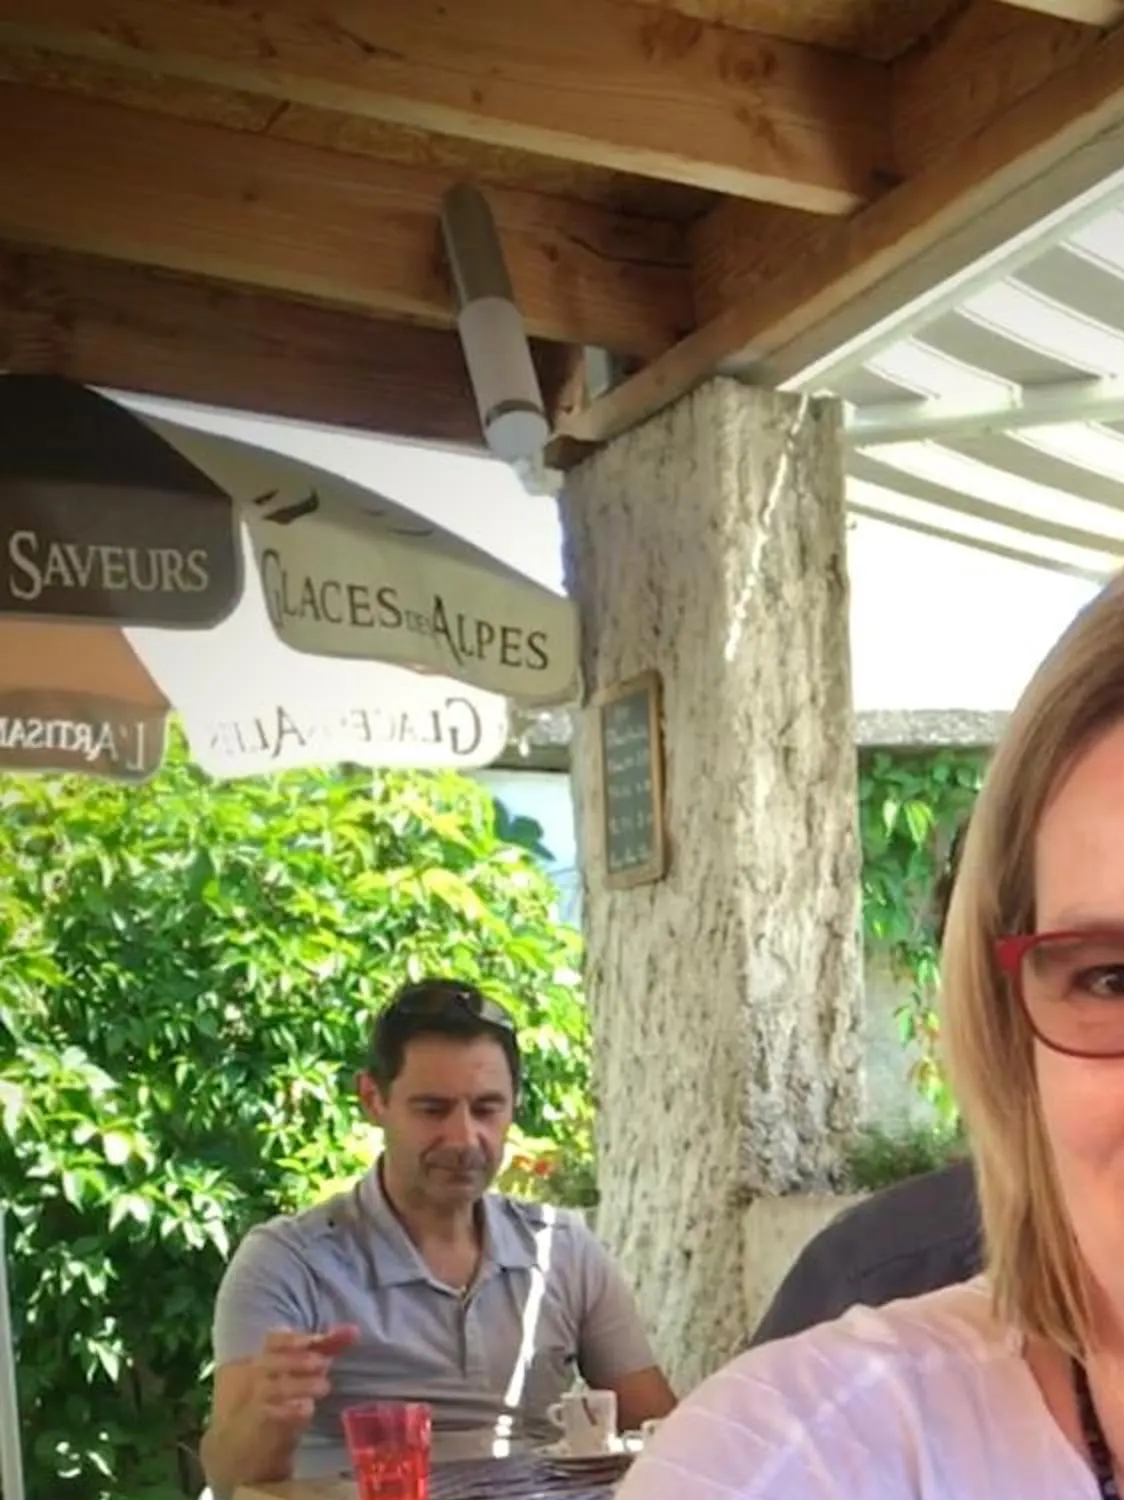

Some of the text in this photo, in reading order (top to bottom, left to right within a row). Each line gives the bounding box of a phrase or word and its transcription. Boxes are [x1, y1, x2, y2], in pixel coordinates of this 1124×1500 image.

[7, 527, 210, 601] SAVEURS
[260, 547, 403, 629] GLACES
[430, 594, 549, 671] ALPES
